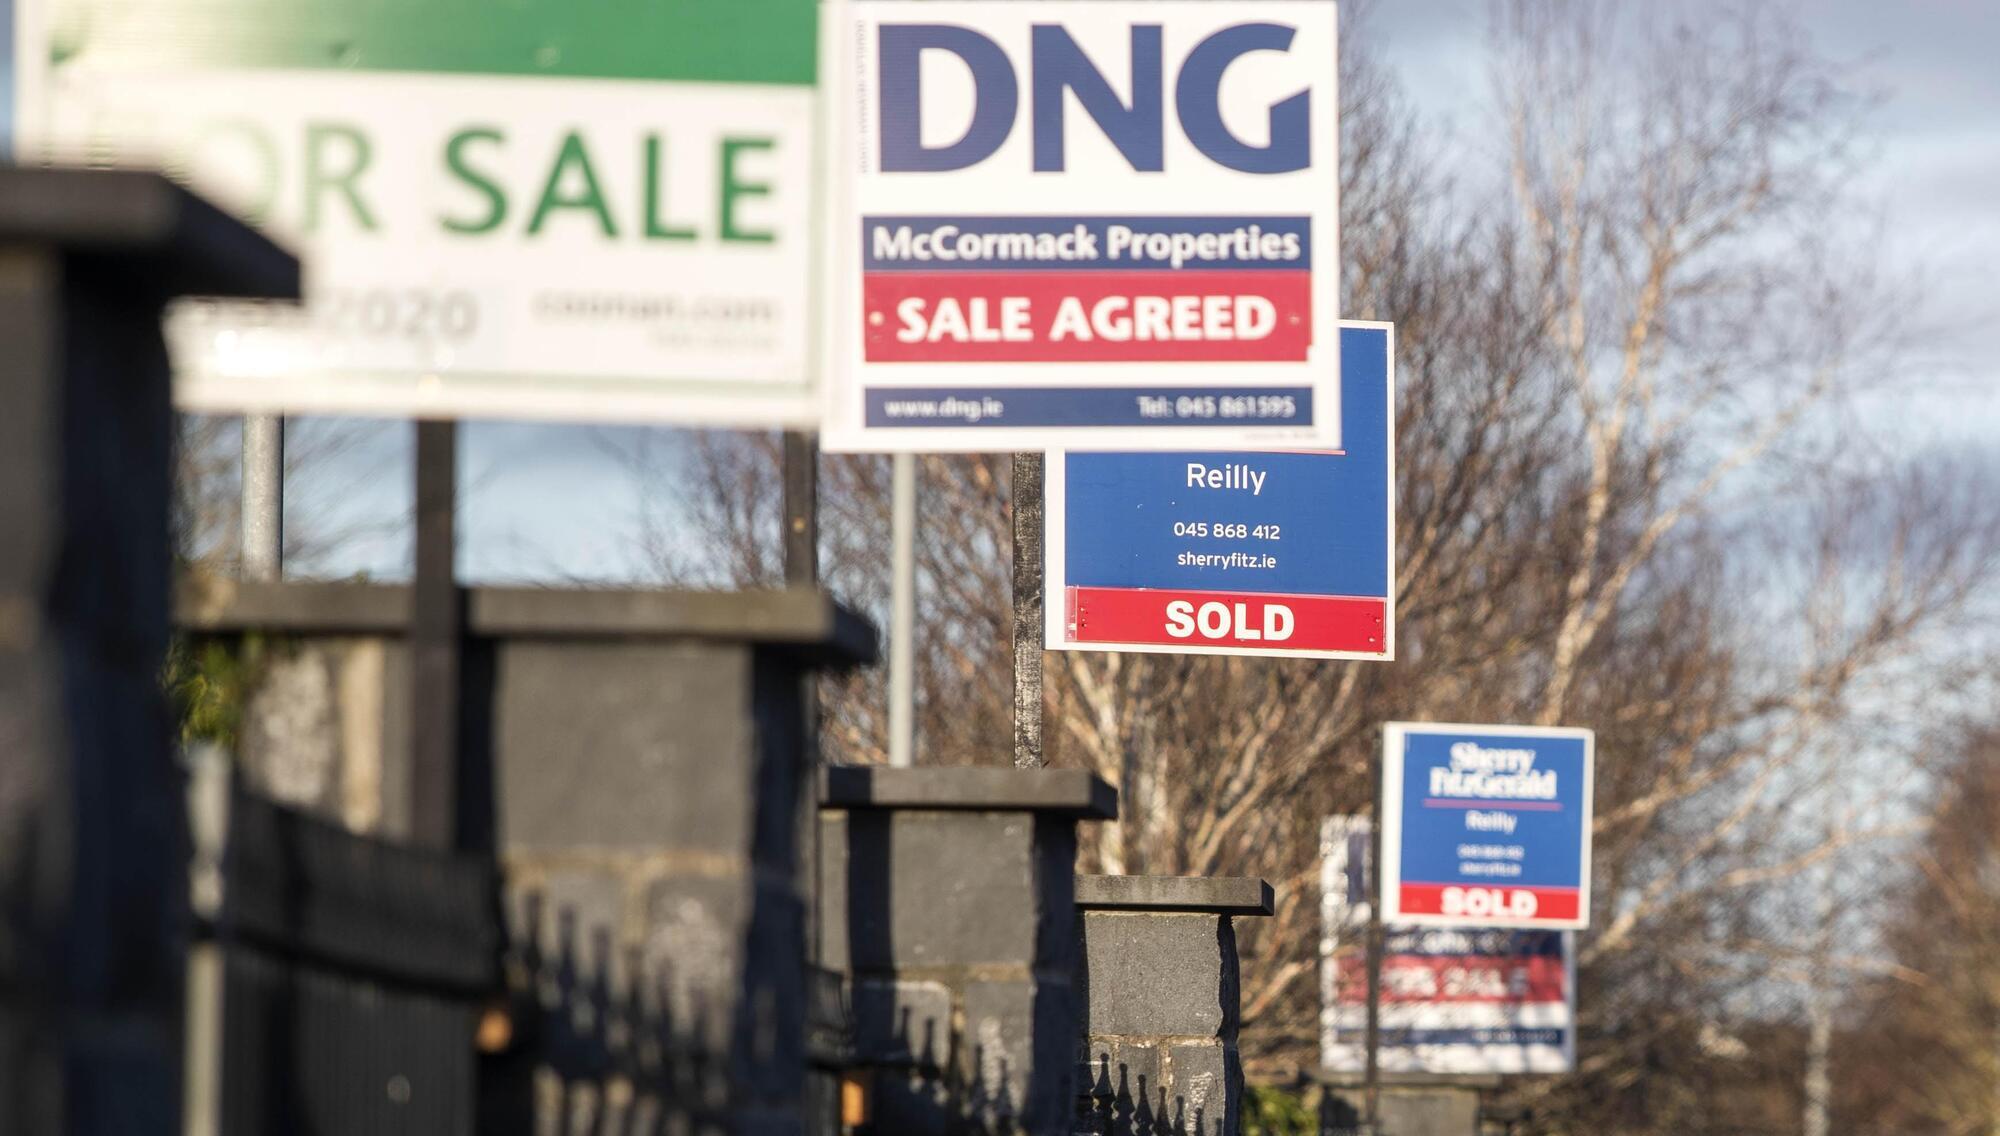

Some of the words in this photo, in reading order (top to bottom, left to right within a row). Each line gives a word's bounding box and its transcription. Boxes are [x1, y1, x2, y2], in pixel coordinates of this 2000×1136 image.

[878, 22, 1311, 174] DNG
[438, 125, 778, 243] SALE
[873, 225, 1098, 261] McCormack
[1106, 225, 1300, 268] Properties
[897, 297, 1033, 343] SALE
[1049, 296, 1276, 341] AGREED
[884, 397, 1003, 422] www.dng.ie
[1187, 463, 1266, 495] Reilly
[1173, 522, 1208, 538] 045
[1213, 523, 1247, 539] 868
[1252, 524, 1281, 540] 412
[1177, 552, 1277, 569] sherryfitz.ie
[1165, 600, 1295, 641] SOLD
[1449, 742, 1536, 775] Sherry
[1465, 810, 1517, 834] Reilly
[1440, 888, 1538, 917] SOLD
